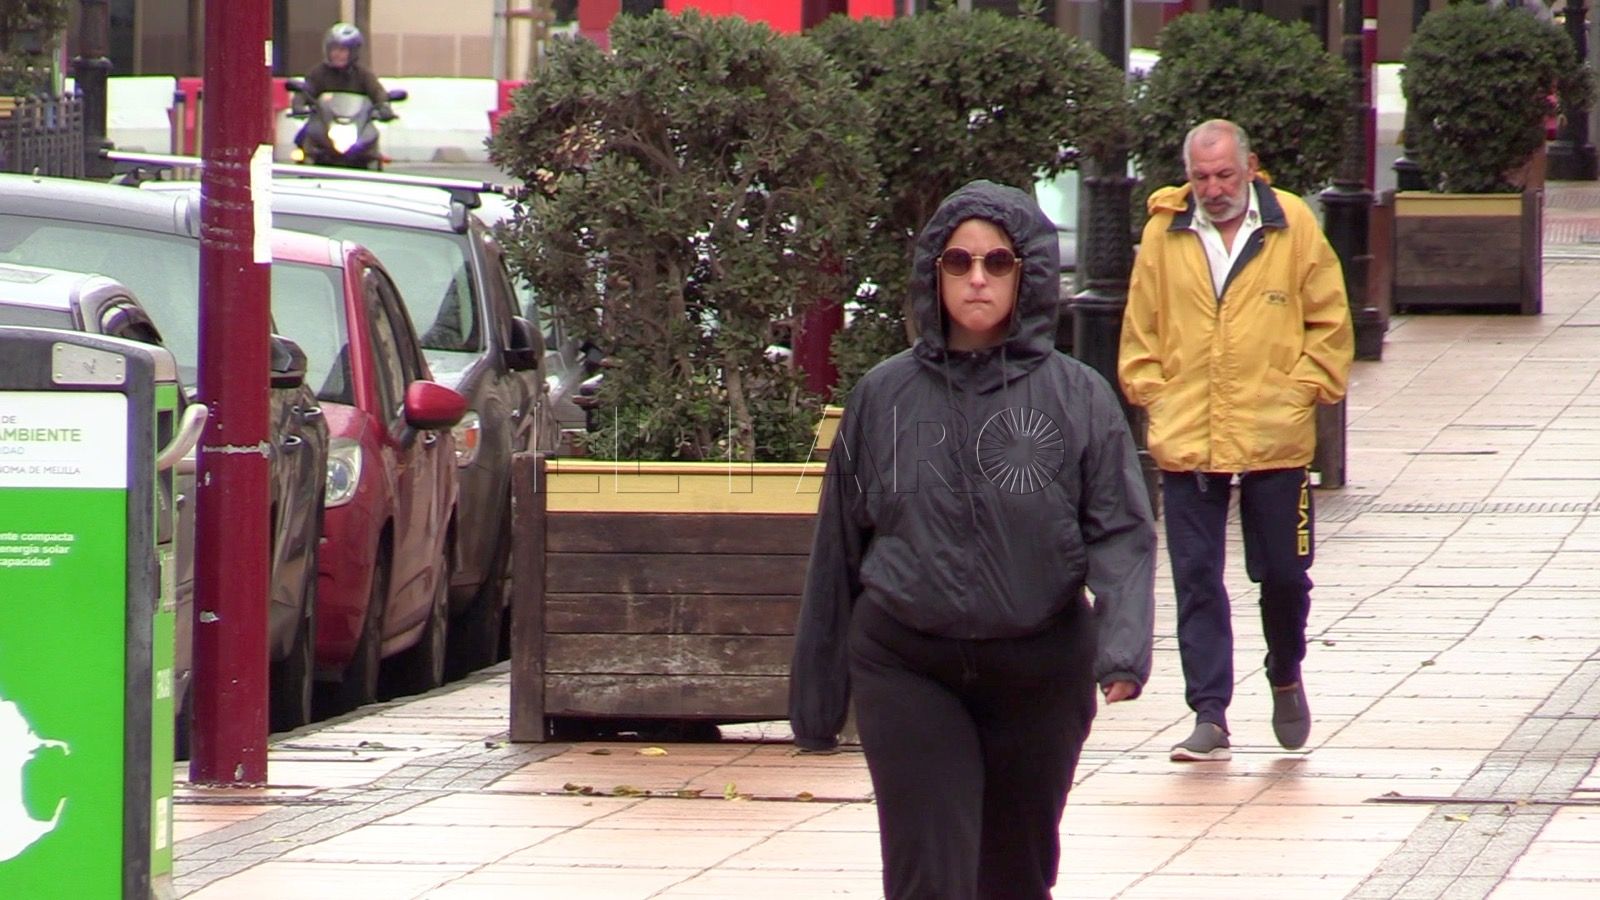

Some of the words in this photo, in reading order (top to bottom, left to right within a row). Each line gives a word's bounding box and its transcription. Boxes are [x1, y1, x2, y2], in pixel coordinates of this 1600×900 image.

[1, 415, 17, 424] DE
[28, 465, 41, 474] DE
[43, 465, 81, 475] MELILLA
[20, 532, 75, 543] compacta
[42, 544, 71, 554] solar
